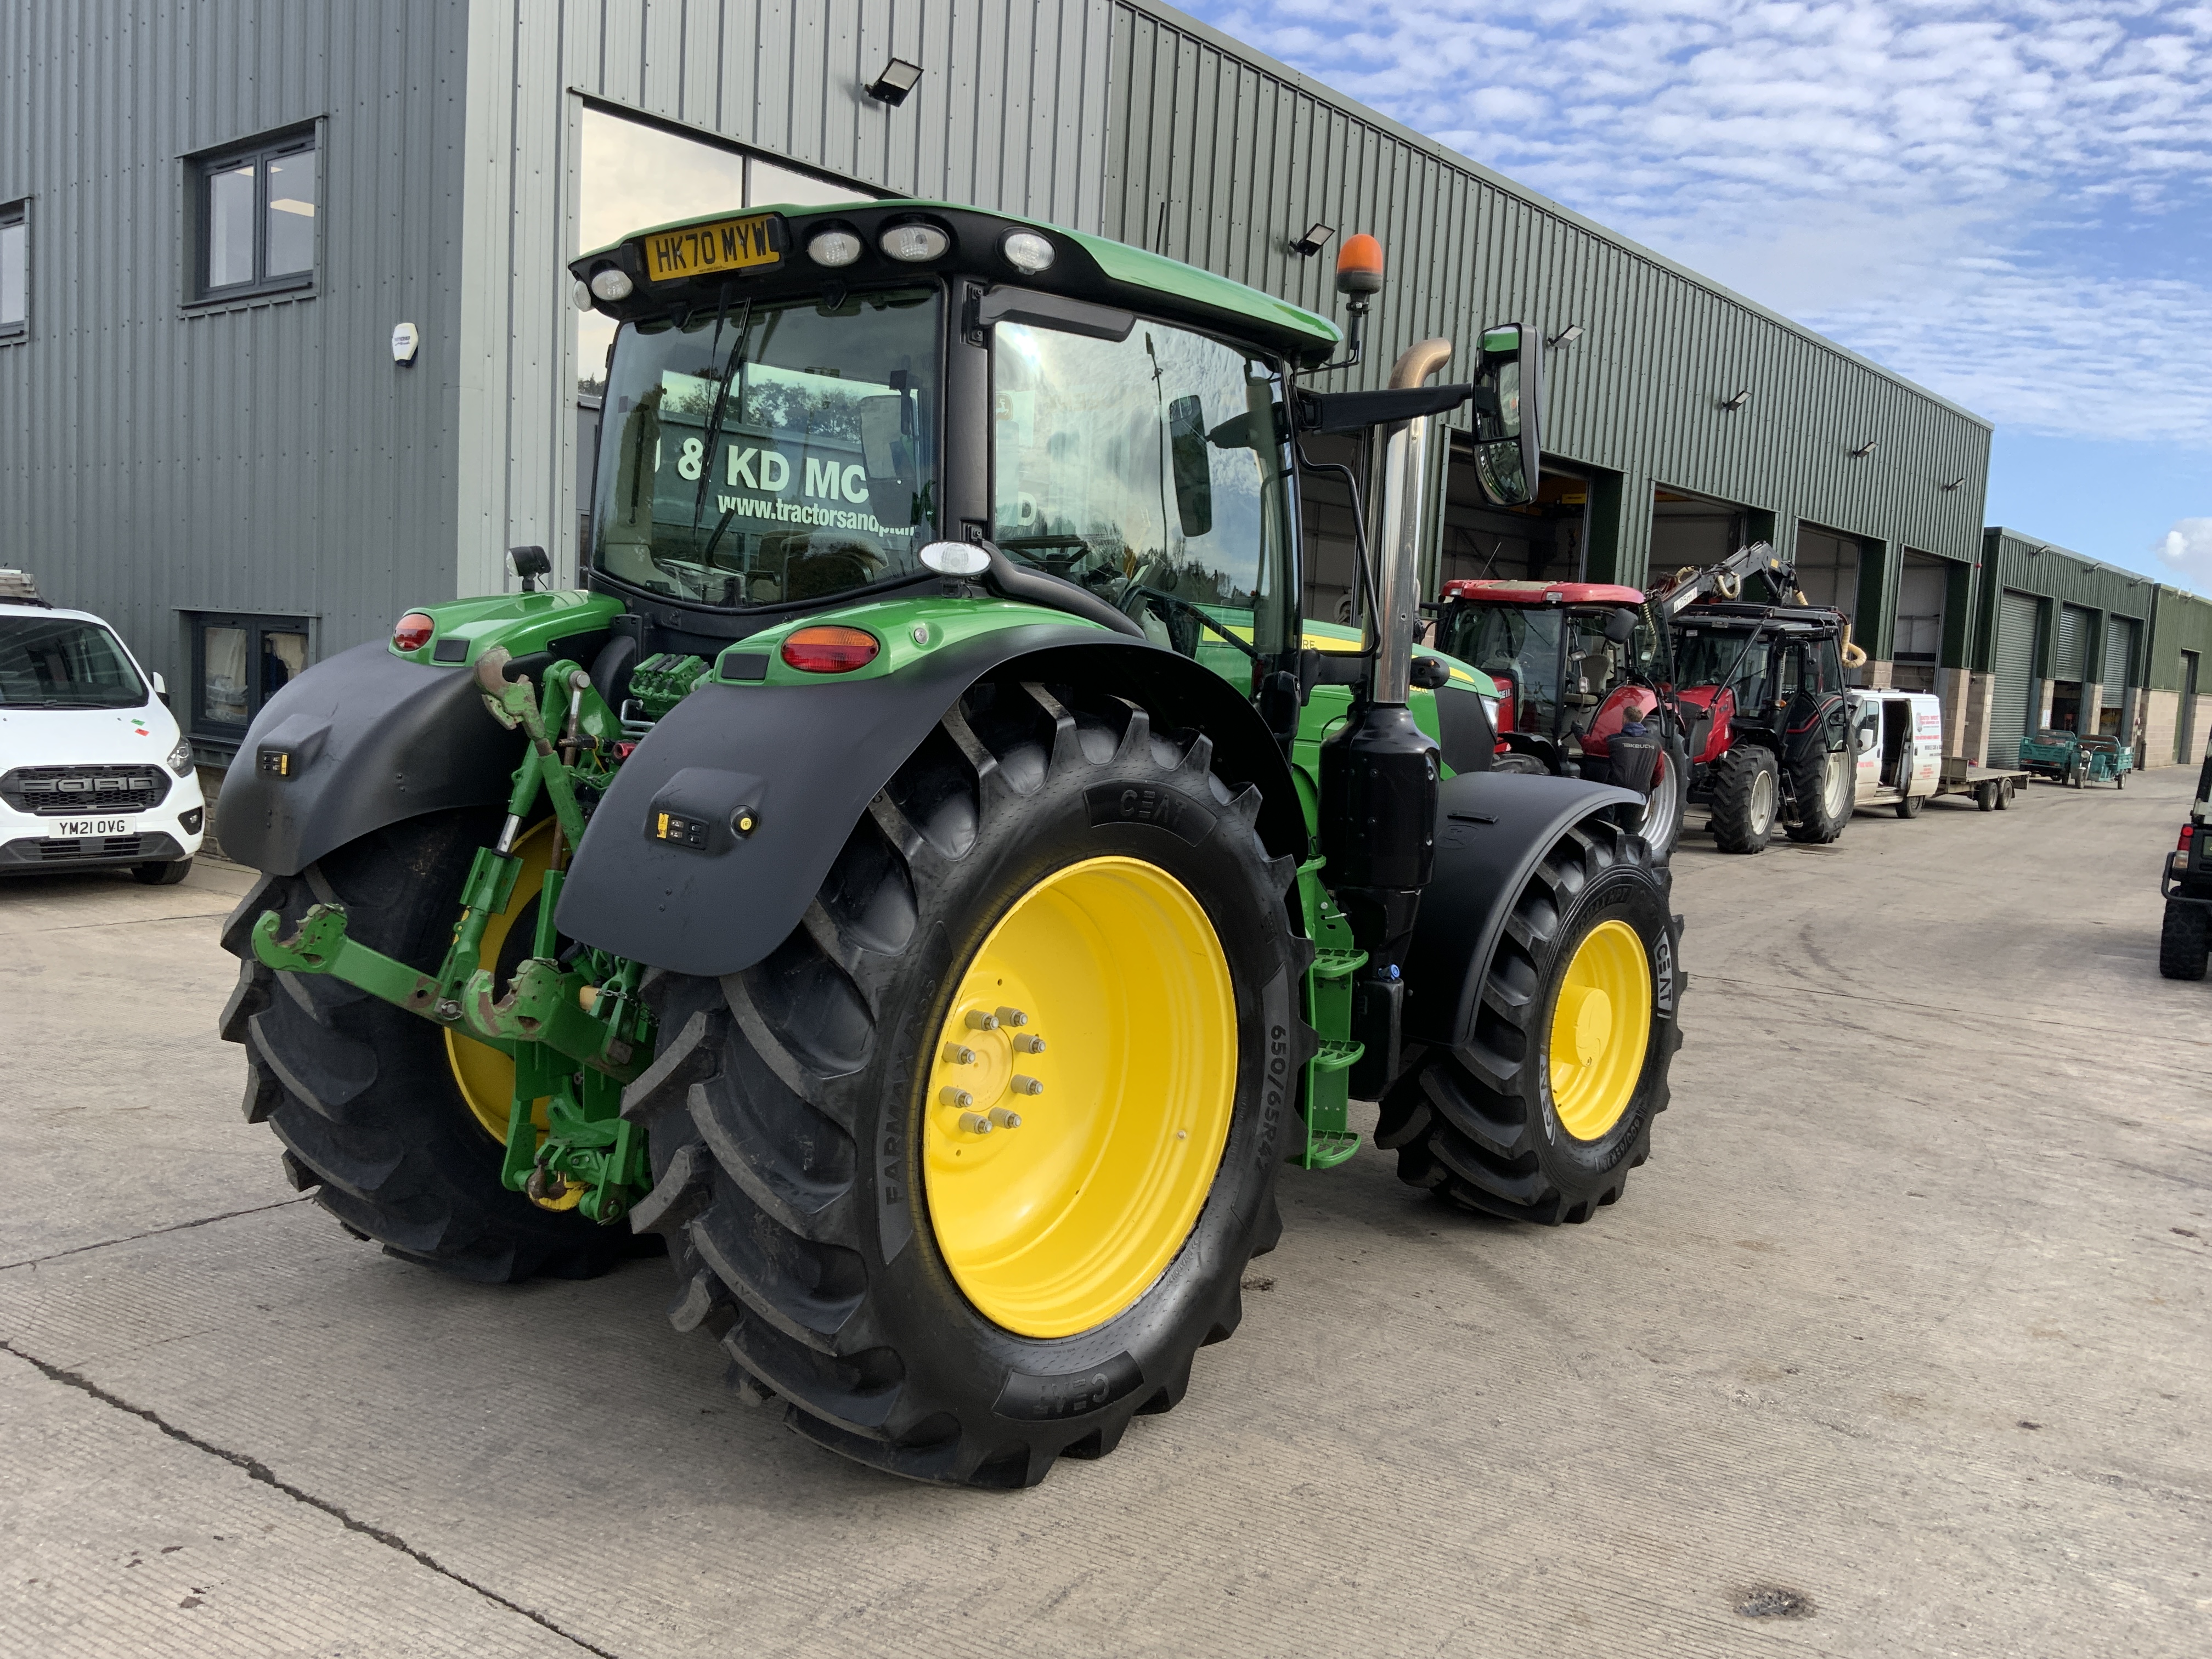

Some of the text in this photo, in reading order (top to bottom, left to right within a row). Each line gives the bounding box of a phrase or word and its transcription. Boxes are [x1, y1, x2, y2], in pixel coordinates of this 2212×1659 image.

[656, 221, 766, 273] HK70 MYW
[727, 444, 790, 492] KD
[805, 457, 870, 504] MC
[718, 495, 915, 538] www.tractorsandp
[59, 820, 125, 835] YM21 OVG
[1120, 789, 1188, 825] CEAT
[1656, 943, 1672, 1002] CEAT
[1032, 1372, 1110, 1414] CEAT
